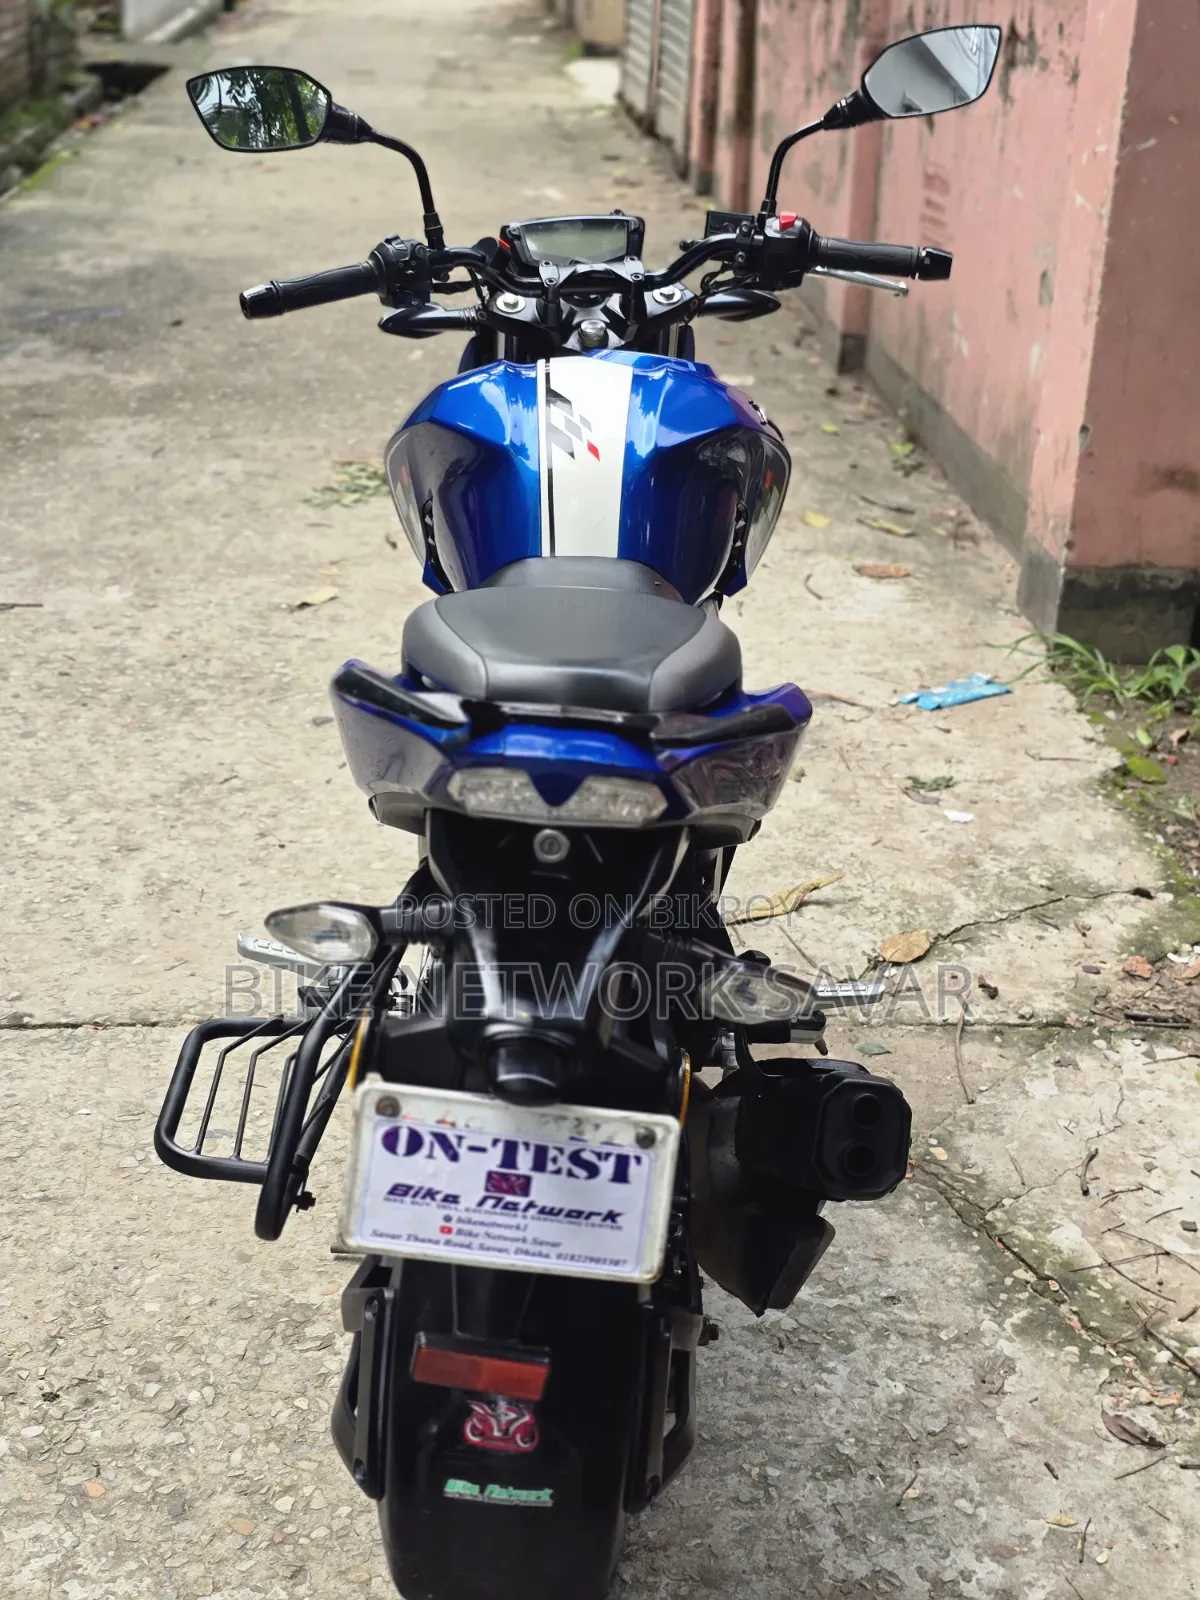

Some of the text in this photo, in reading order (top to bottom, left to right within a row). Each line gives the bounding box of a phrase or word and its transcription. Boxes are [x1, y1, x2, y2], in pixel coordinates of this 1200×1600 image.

[381, 1125, 641, 1184] ON-TEST
[386, 1183, 623, 1224] Bike Network
